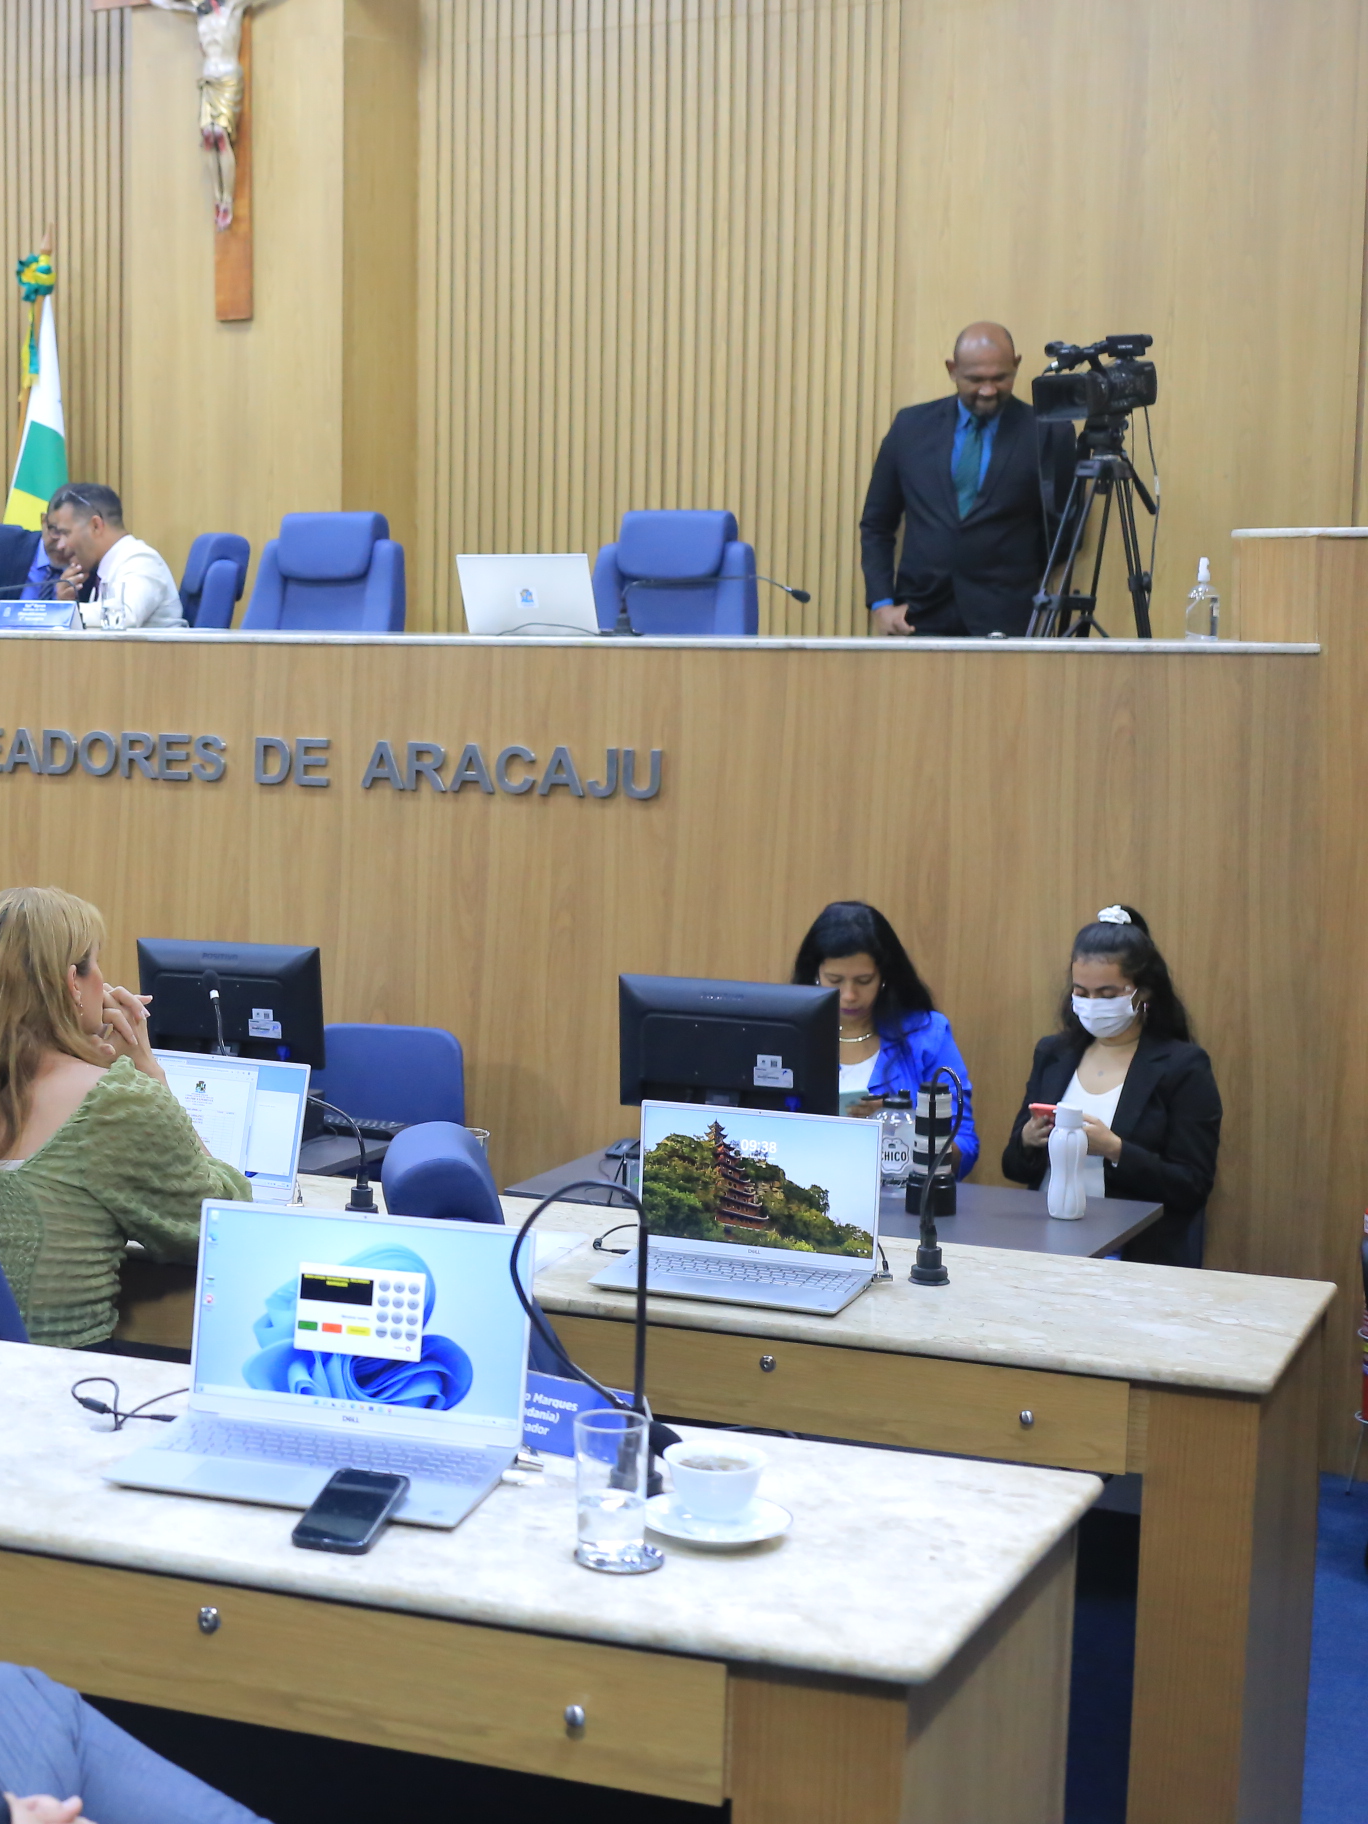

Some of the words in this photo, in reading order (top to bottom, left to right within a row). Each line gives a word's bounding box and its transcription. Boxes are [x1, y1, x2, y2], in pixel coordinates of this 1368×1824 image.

[254, 736, 330, 787] DE
[361, 740, 663, 800] ARACAJU
[740, 1139, 777, 1154] 09:38
[881, 1151, 907, 1162] HICO
[533, 1392, 579, 1412] Marques
